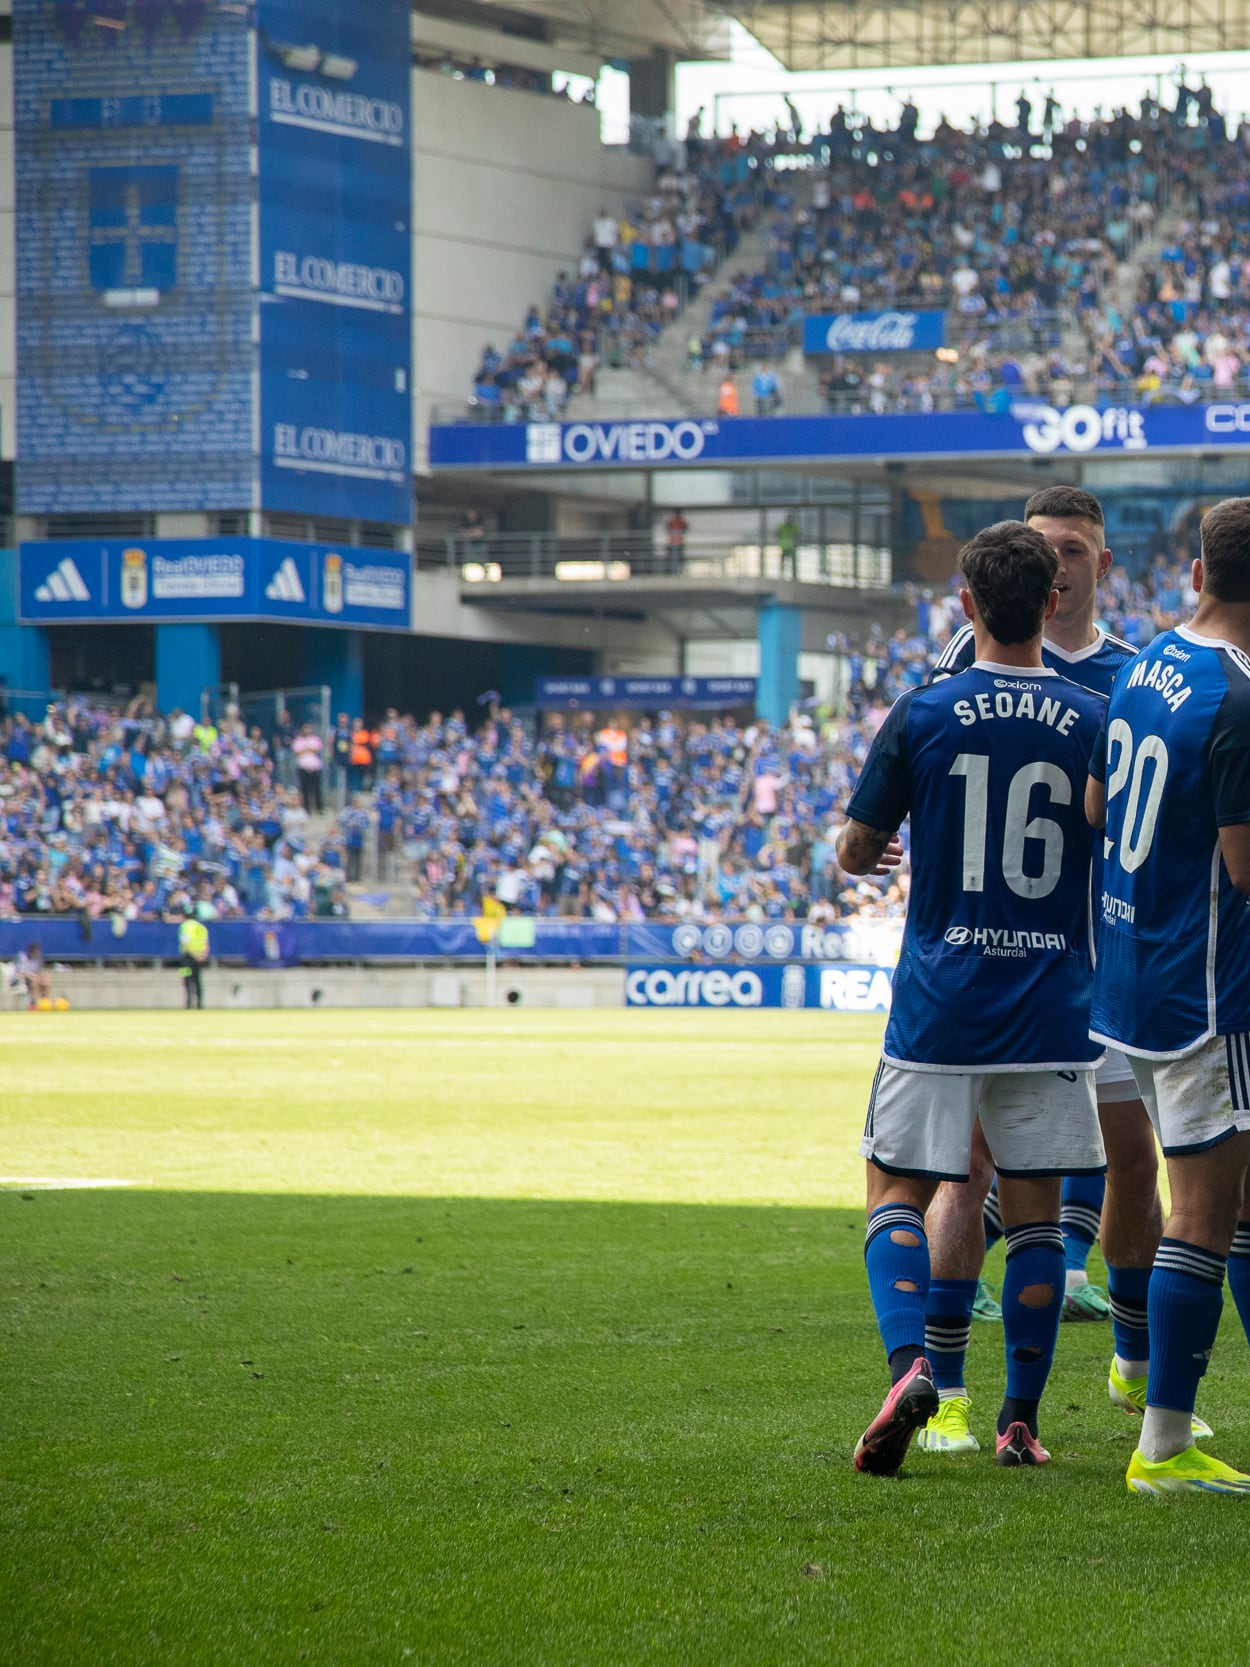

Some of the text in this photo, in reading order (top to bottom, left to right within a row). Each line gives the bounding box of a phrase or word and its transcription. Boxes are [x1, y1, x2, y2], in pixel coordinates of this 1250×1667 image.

[271, 77, 403, 134] EL COMERCIO
[275, 251, 405, 301] EL COMERCIO
[826, 312, 919, 351] Coca-Cola
[275, 423, 405, 469] EL COMERCIO
[563, 421, 705, 462] OVIEDO
[1127, 659, 1192, 713] MASCA
[953, 691, 1080, 737] SEOANE
[1104, 718, 1169, 874] 20
[949, 753, 1073, 899] 16
[973, 927, 1067, 951] HYUNDAI
[983, 945, 1027, 958] Asturdai
